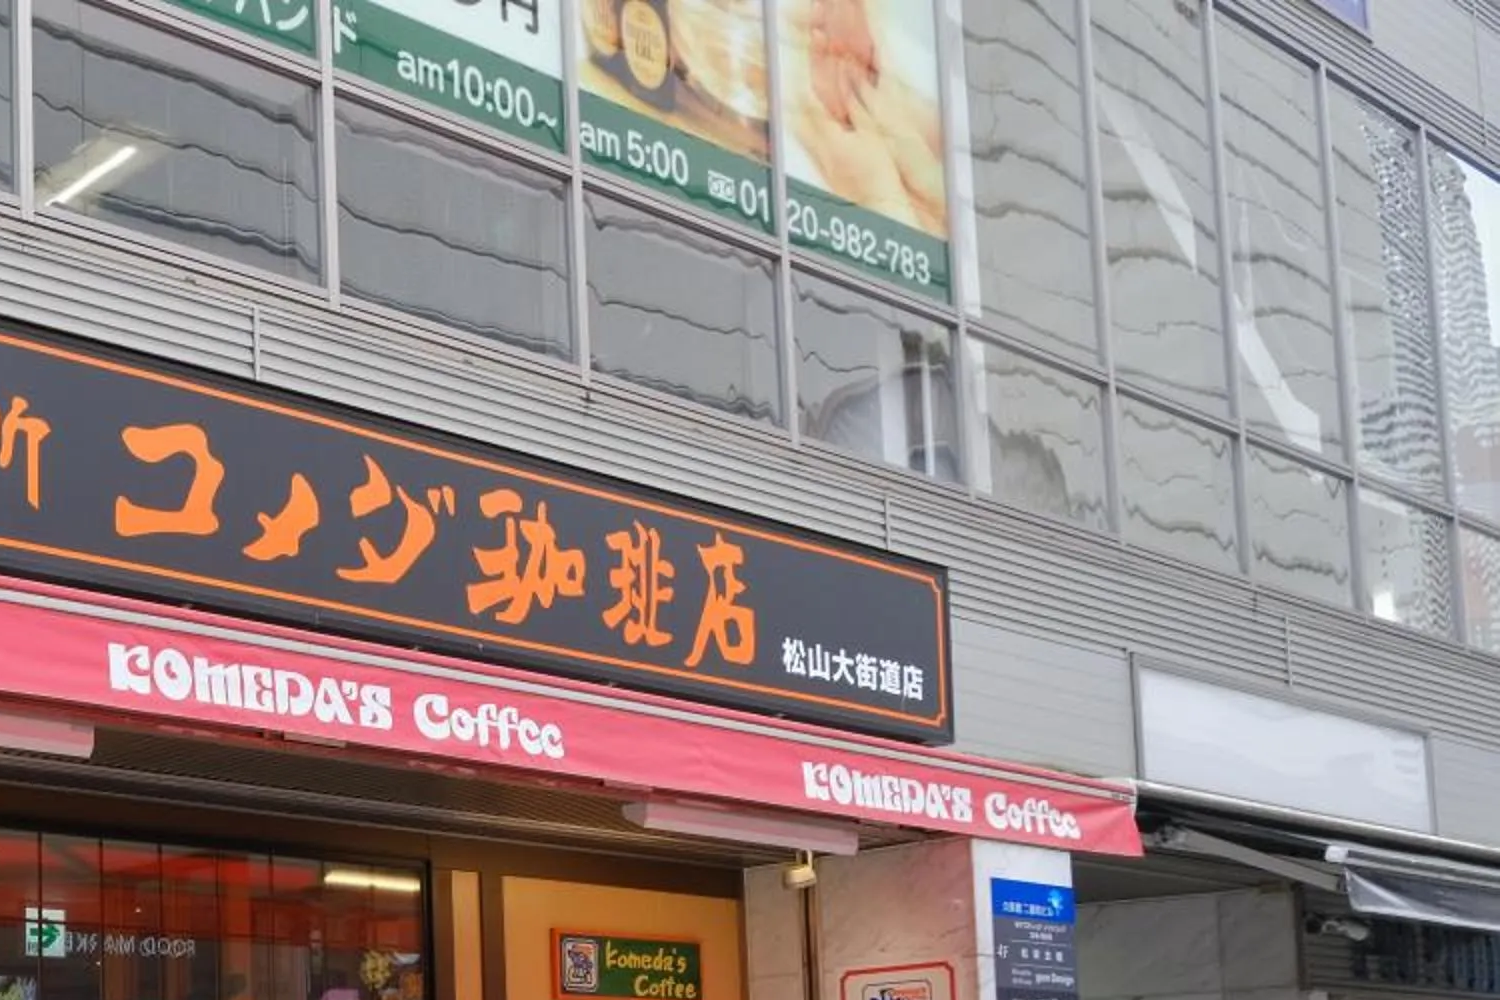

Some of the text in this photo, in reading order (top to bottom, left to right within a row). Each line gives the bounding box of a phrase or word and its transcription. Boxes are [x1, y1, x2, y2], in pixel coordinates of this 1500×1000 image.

[626, 129, 689, 187] 5:00
[114, 424, 756, 668] コメダ珈琲店
[781, 636, 924, 701] 松山大街道店
[412, 692, 566, 760] Coffee
[983, 792, 1082, 841] Coffee
[633, 973, 697, 999] Coffee
